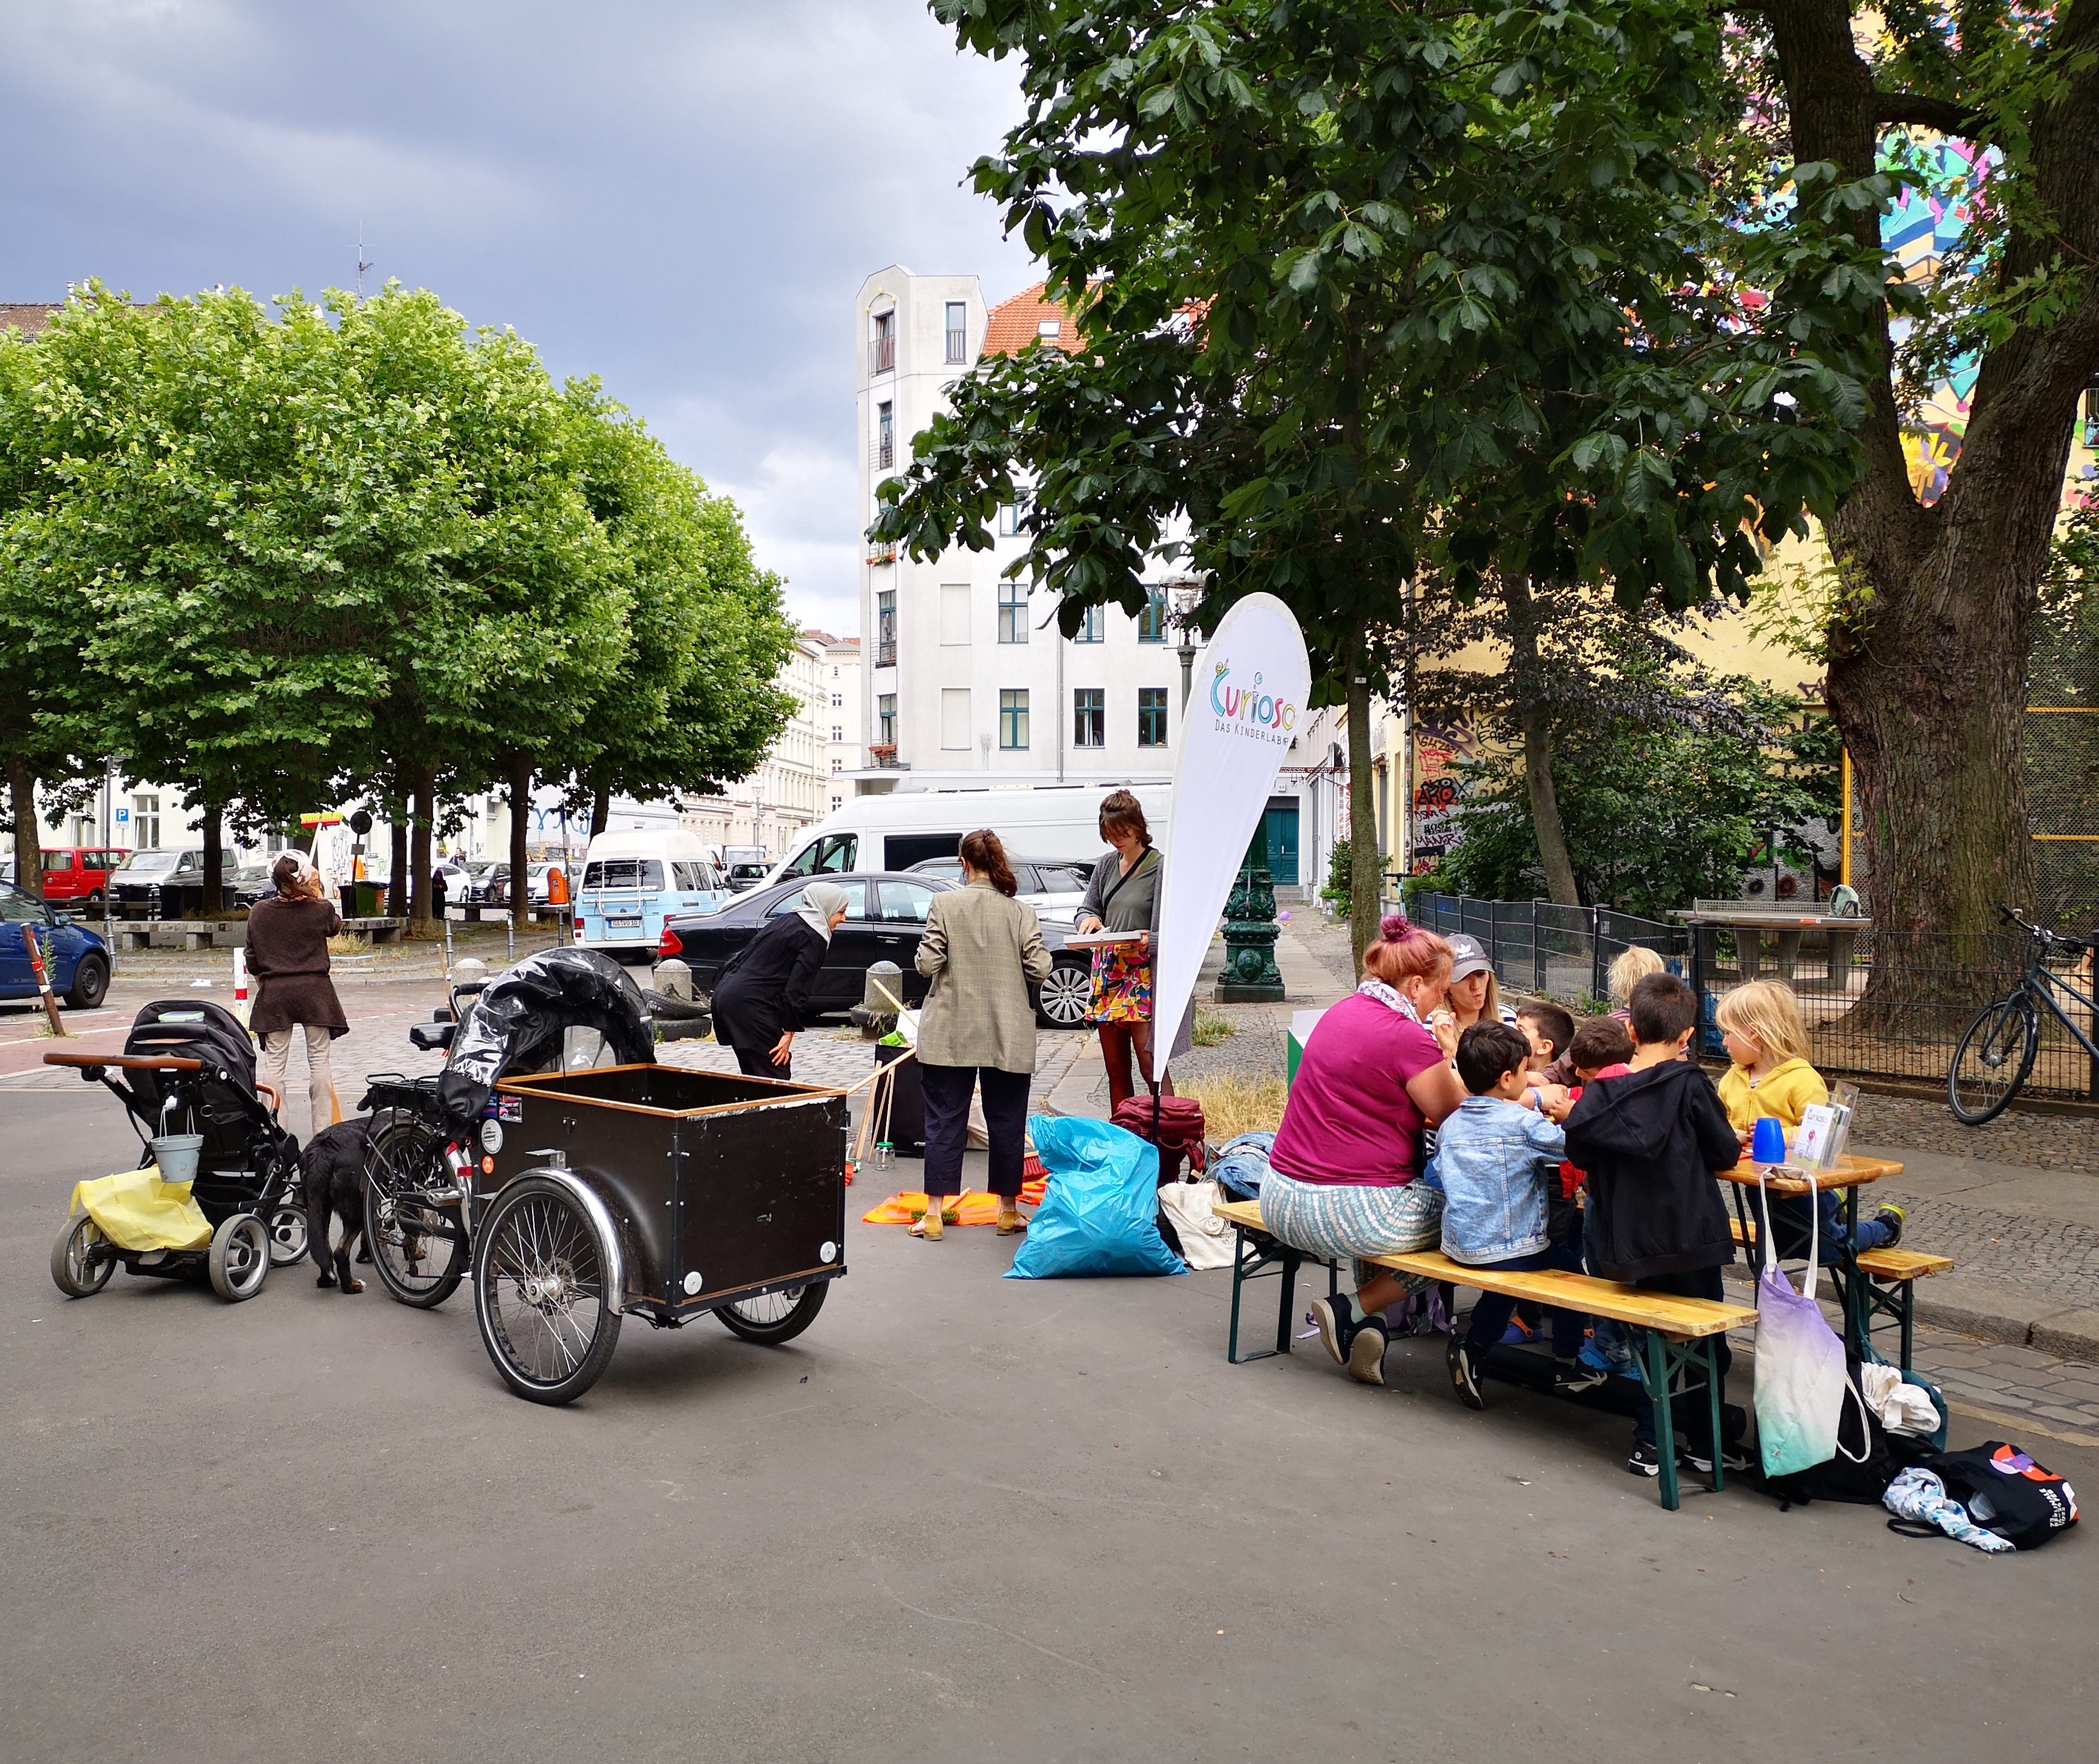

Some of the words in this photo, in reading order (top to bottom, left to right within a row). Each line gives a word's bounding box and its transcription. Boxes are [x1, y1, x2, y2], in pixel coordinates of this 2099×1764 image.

[1210, 668, 1296, 731] Curioso
[1215, 719, 1230, 733] DAS
[118, 810, 126, 820] P
